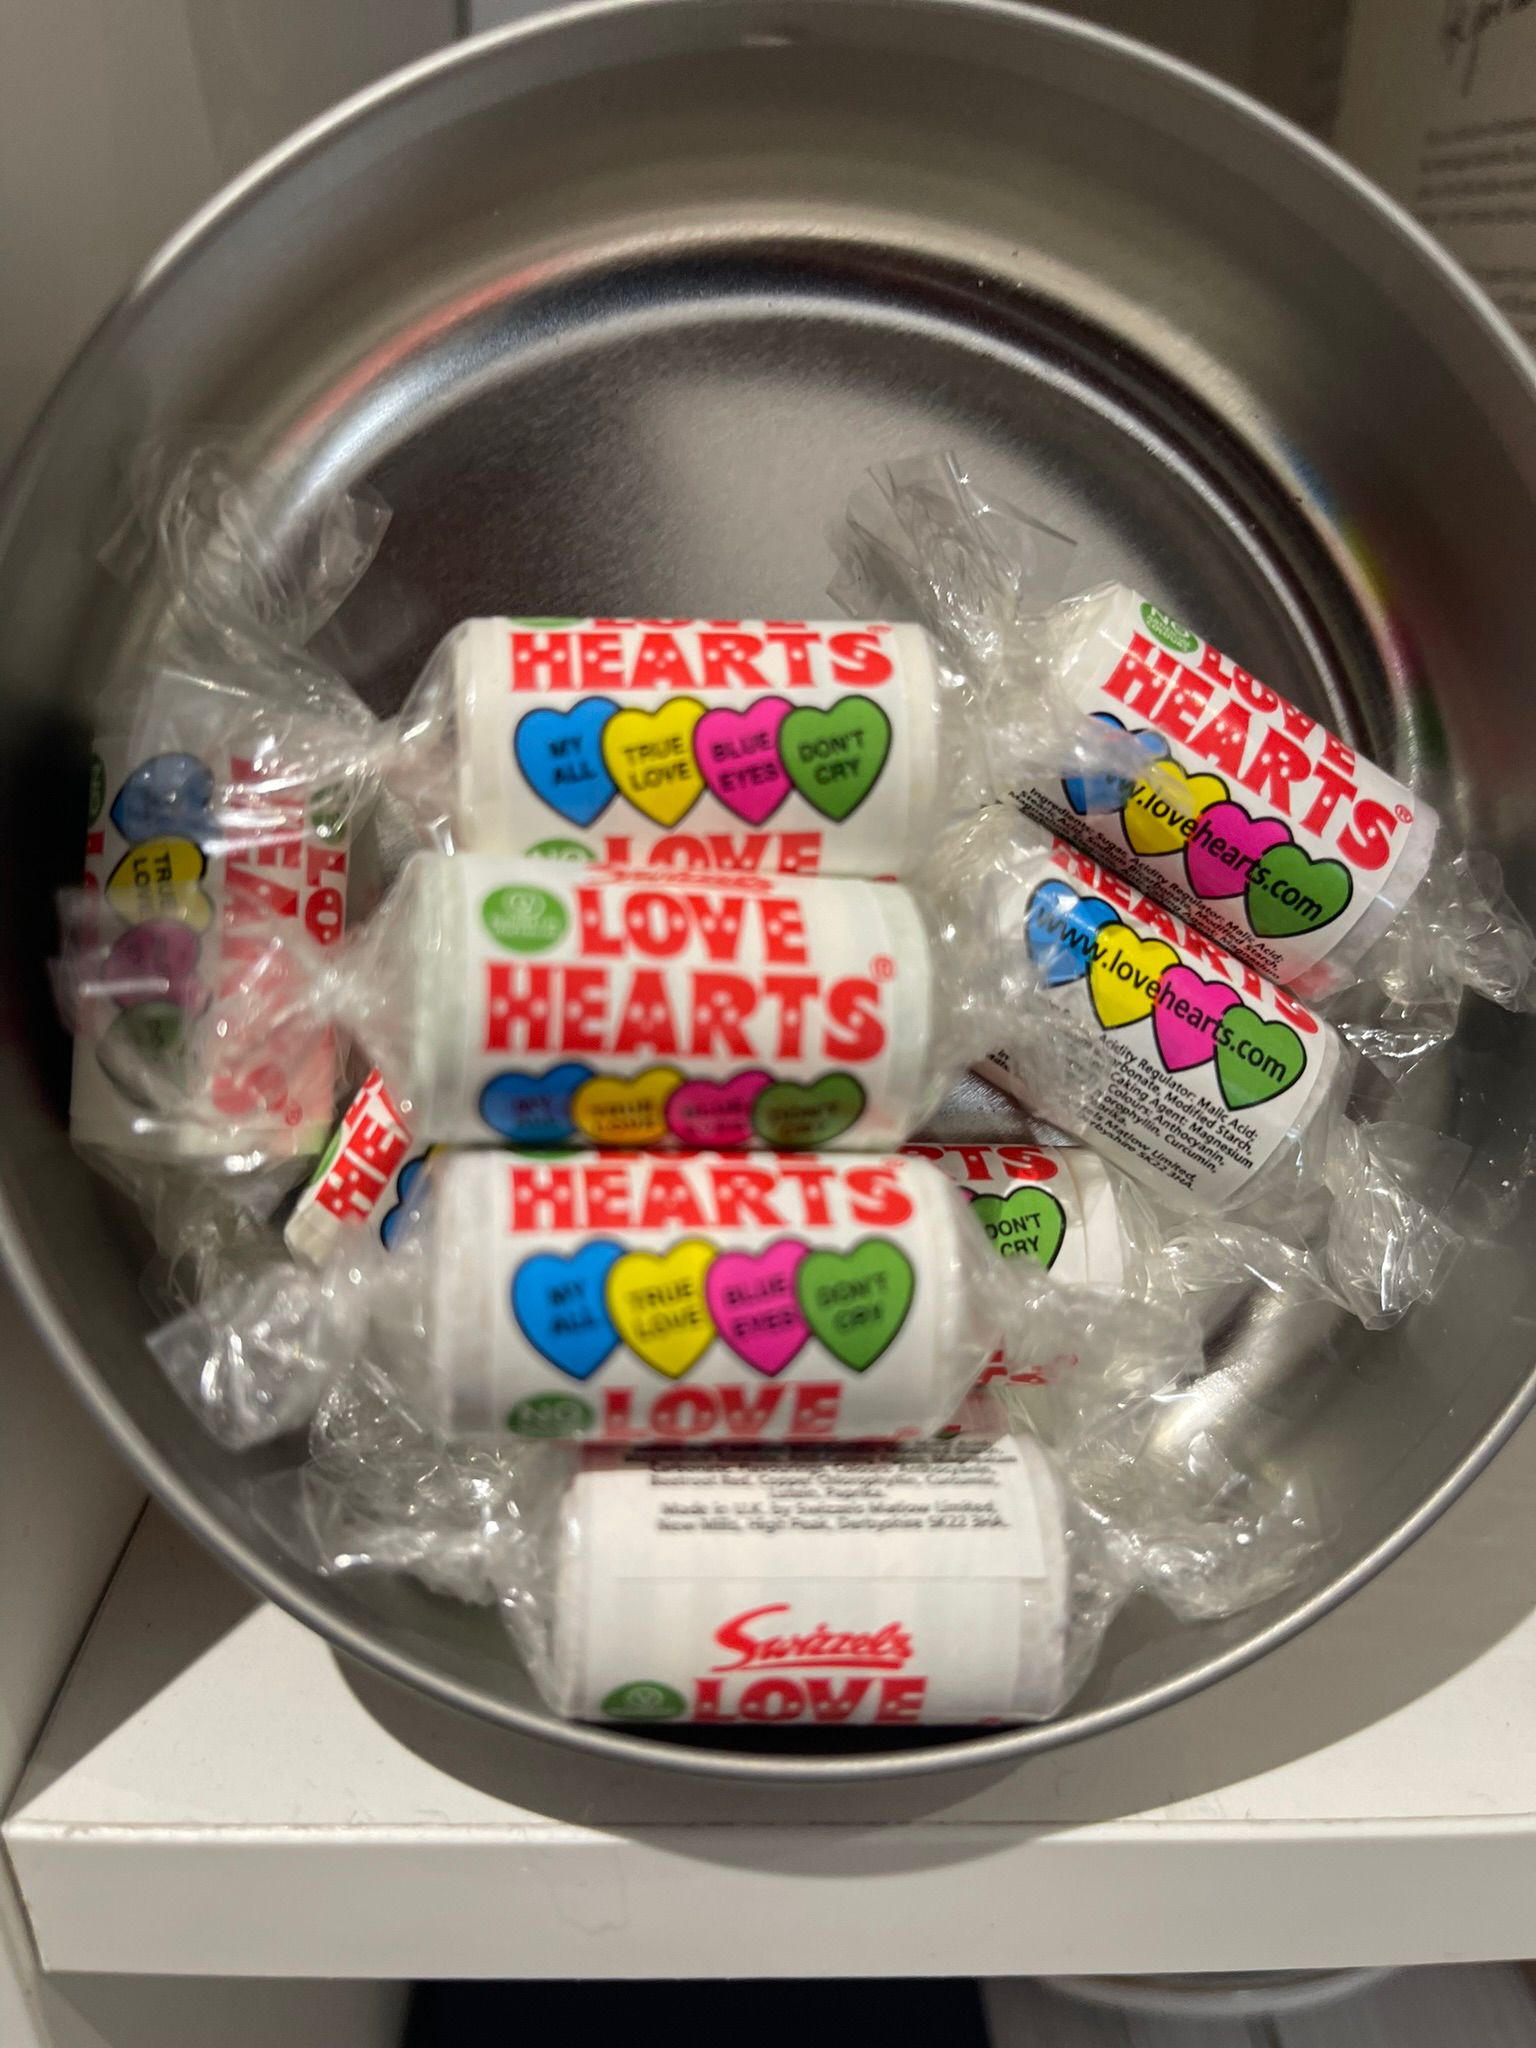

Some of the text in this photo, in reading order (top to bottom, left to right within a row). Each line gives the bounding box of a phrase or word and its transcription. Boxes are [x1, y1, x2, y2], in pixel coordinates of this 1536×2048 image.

[510, 632, 893, 692] HEARTS
[548, 736, 583, 759] MY
[624, 736, 683, 765] TRUE
[713, 733, 770, 761] BLUE
[799, 730, 864, 762] DON'T
[554, 763, 596, 786] ALL
[629, 762, 690, 793] LOVE
[719, 761, 778, 793] EYES
[815, 759, 861, 785] CRY
[575, 886, 810, 965] LOVE
[1036, 906, 1286, 1082] www.lovehearts.com
[1137, 1058, 1196, 1102] Regulator:
[1197, 1097, 1228, 1121] Malic
[1107, 1083, 1226, 1166] Colours: Anthocyanin,
[1164, 1091, 1215, 1129] Modified
[1149, 1096, 1187, 1126] Agent:
[1188, 1122, 1253, 1169] Magnesium
[1164, 1133, 1219, 1173] Curcumin,
[510, 1165, 914, 1231] HEARTS
[985, 1213, 1041, 1240] DON'T
[1000, 1236, 1040, 1257] CRY
[601, 1381, 843, 1440] LOVE
[693, 1676, 927, 1724] LOVE
